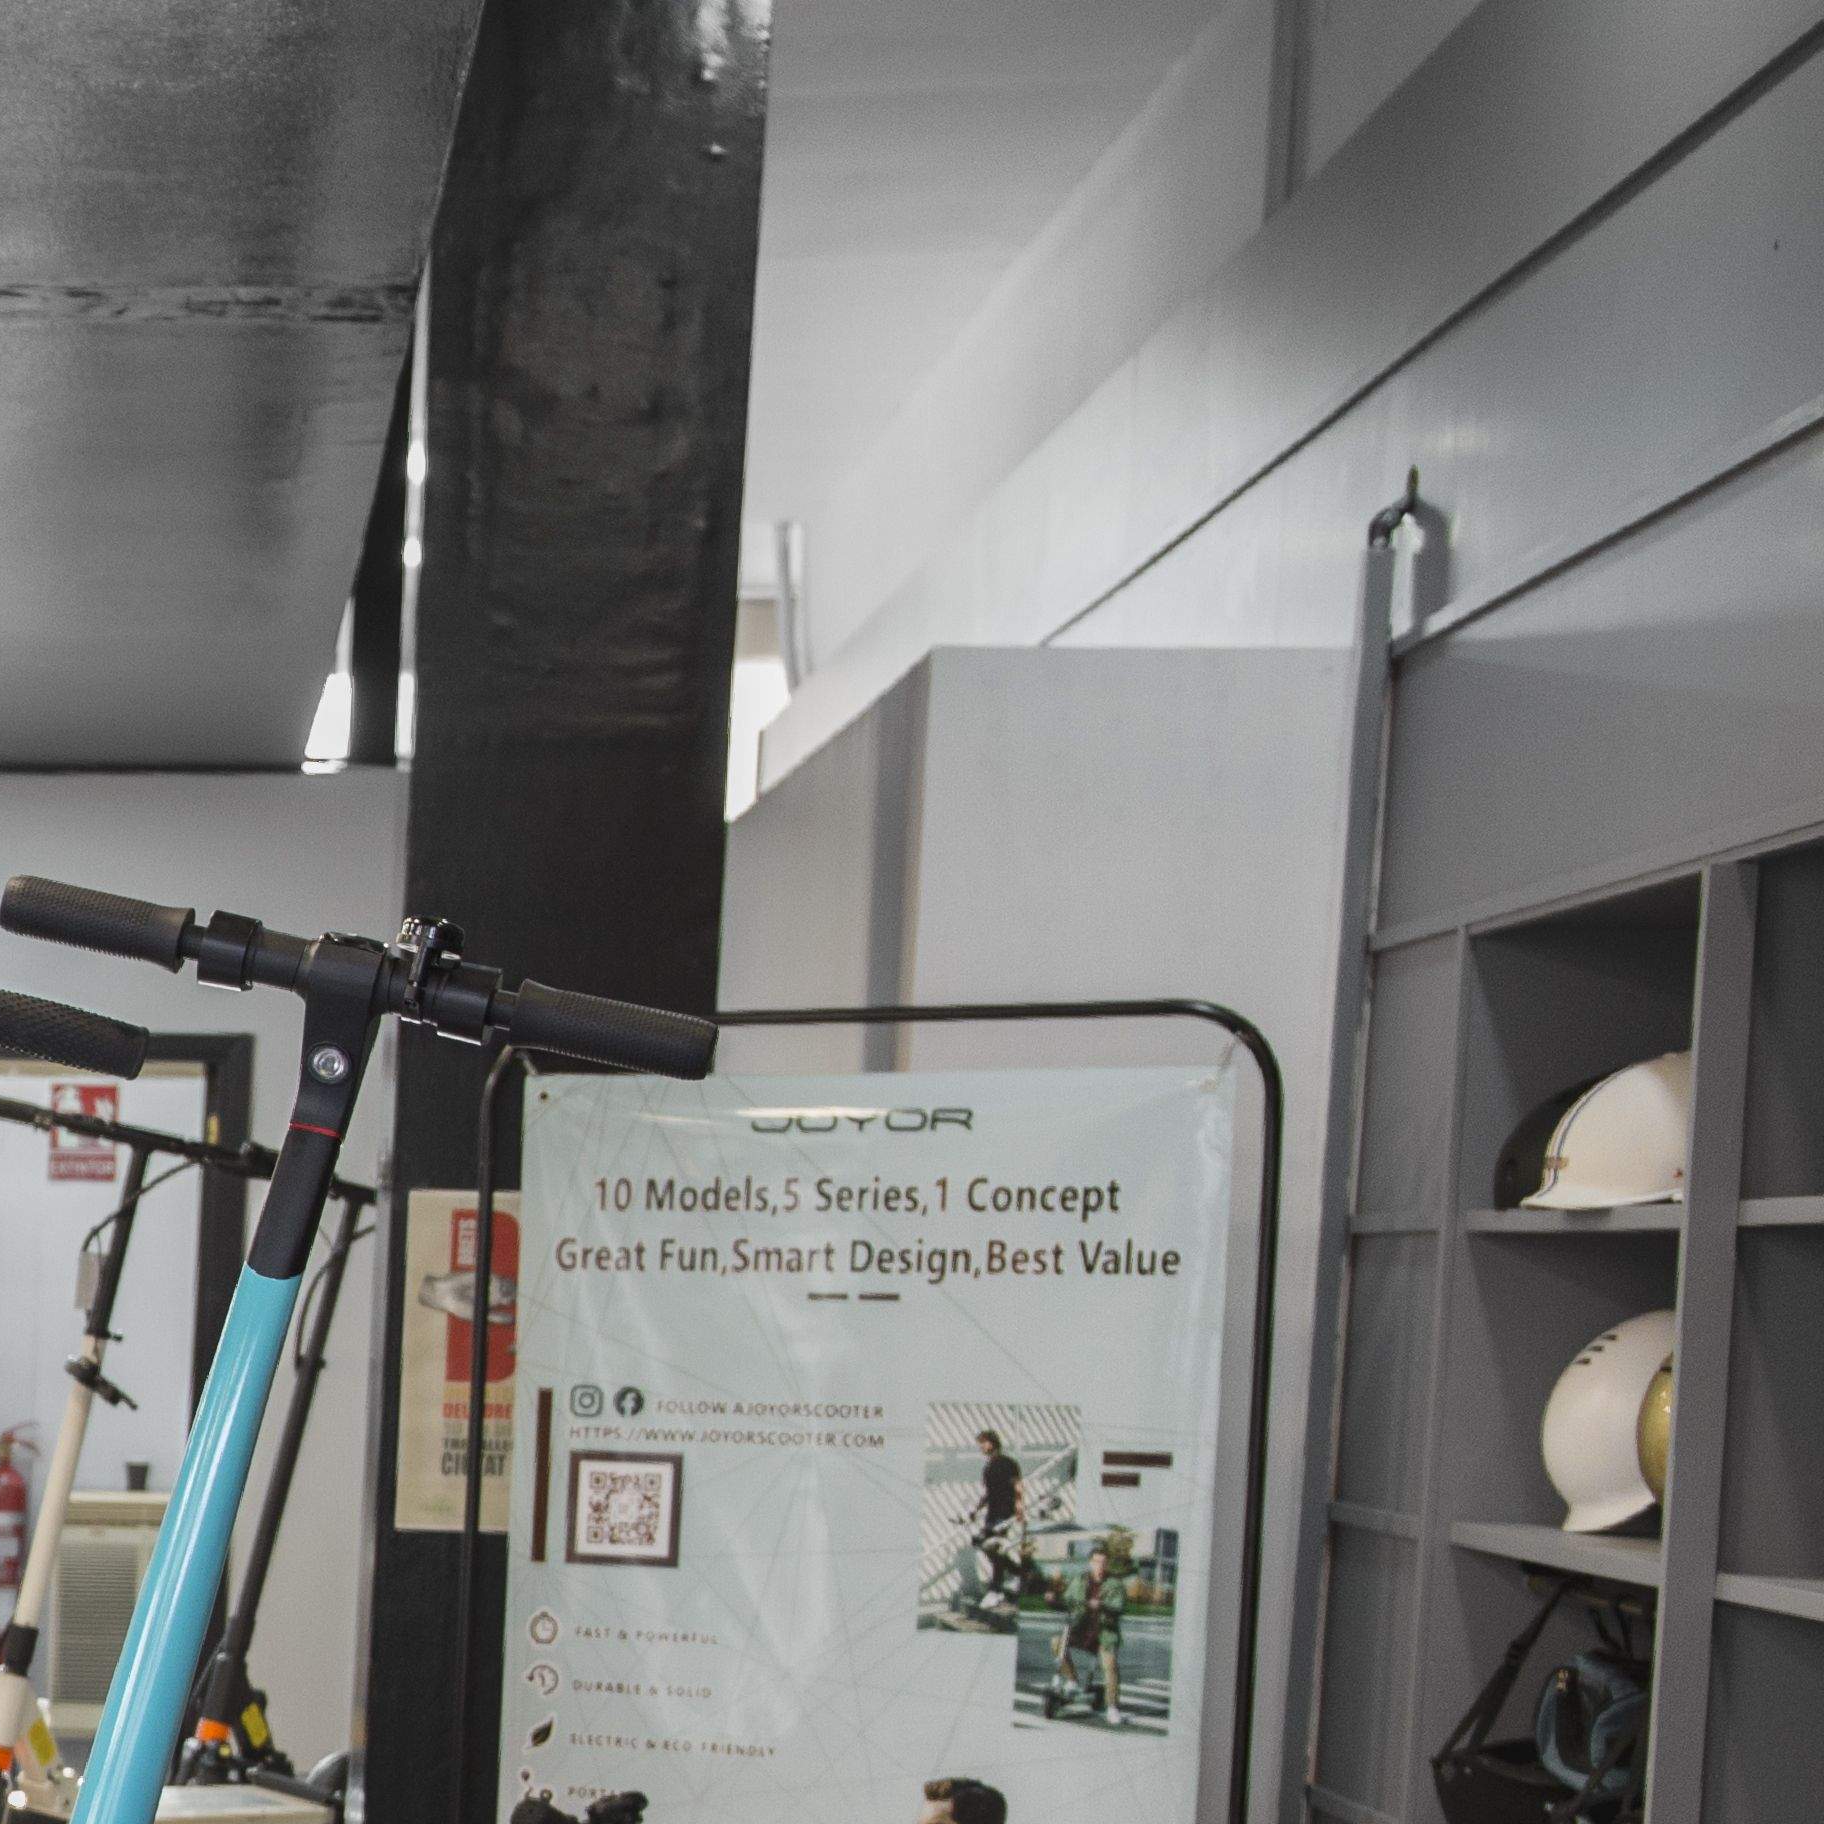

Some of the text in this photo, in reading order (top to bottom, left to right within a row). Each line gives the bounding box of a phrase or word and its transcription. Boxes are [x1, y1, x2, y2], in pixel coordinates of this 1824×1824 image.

[594, 1176, 1122, 1221] 10 Models,5 Series,1 Concept
[554, 1238, 1183, 1283] Great Fun,Smart Design,Best Value
[657, 1399, 727, 1416] FOLLOW
[574, 1627, 611, 1641] FAST
[569, 1732, 639, 1749] ELECTRIC
